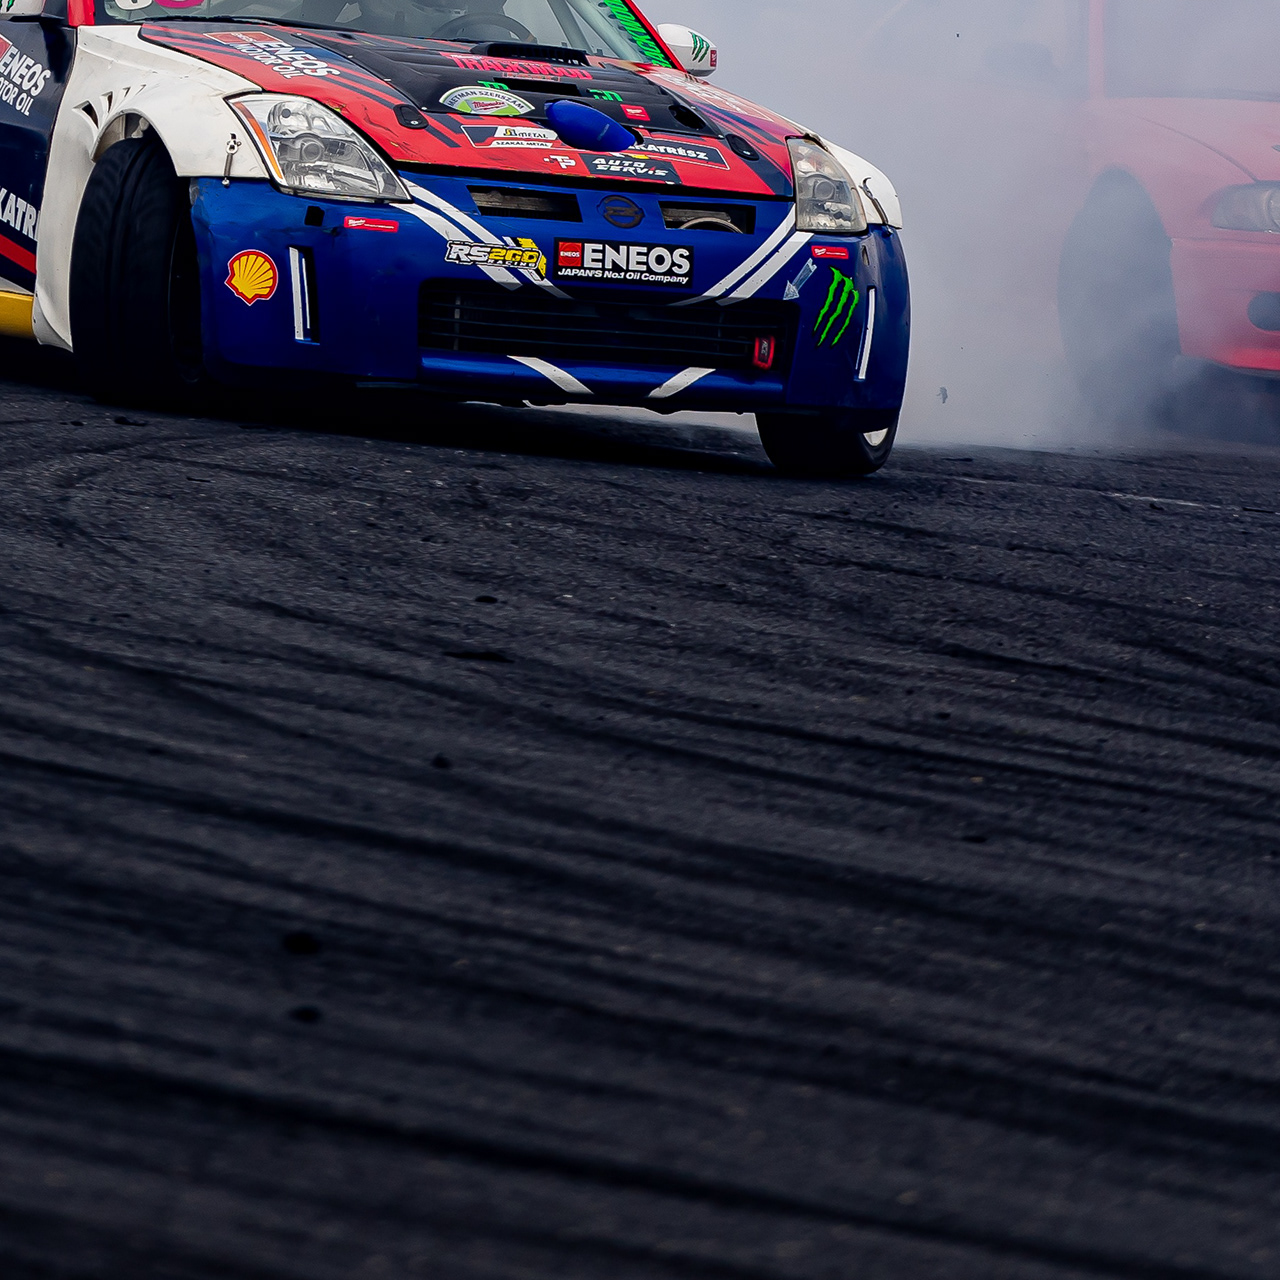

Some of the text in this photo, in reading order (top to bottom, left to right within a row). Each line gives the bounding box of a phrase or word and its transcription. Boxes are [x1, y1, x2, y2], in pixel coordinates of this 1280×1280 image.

[228, 42, 305, 79] MOTOR OIL
[255, 40, 341, 77] ENEOS
[449, 56, 593, 80] TRACKWOOD
[15, 92, 34, 117] OIL
[628, 140, 709, 161] KATRÉSZ
[592, 158, 647, 168] AUTO
[596, 164, 669, 177] SERVIS
[487, 259, 537, 268] RACING
[560, 250, 581, 258] ENEOS
[583, 243, 690, 274] ENEOS
[558, 268, 689, 284] JAPAN'S No.1 Oil Company
